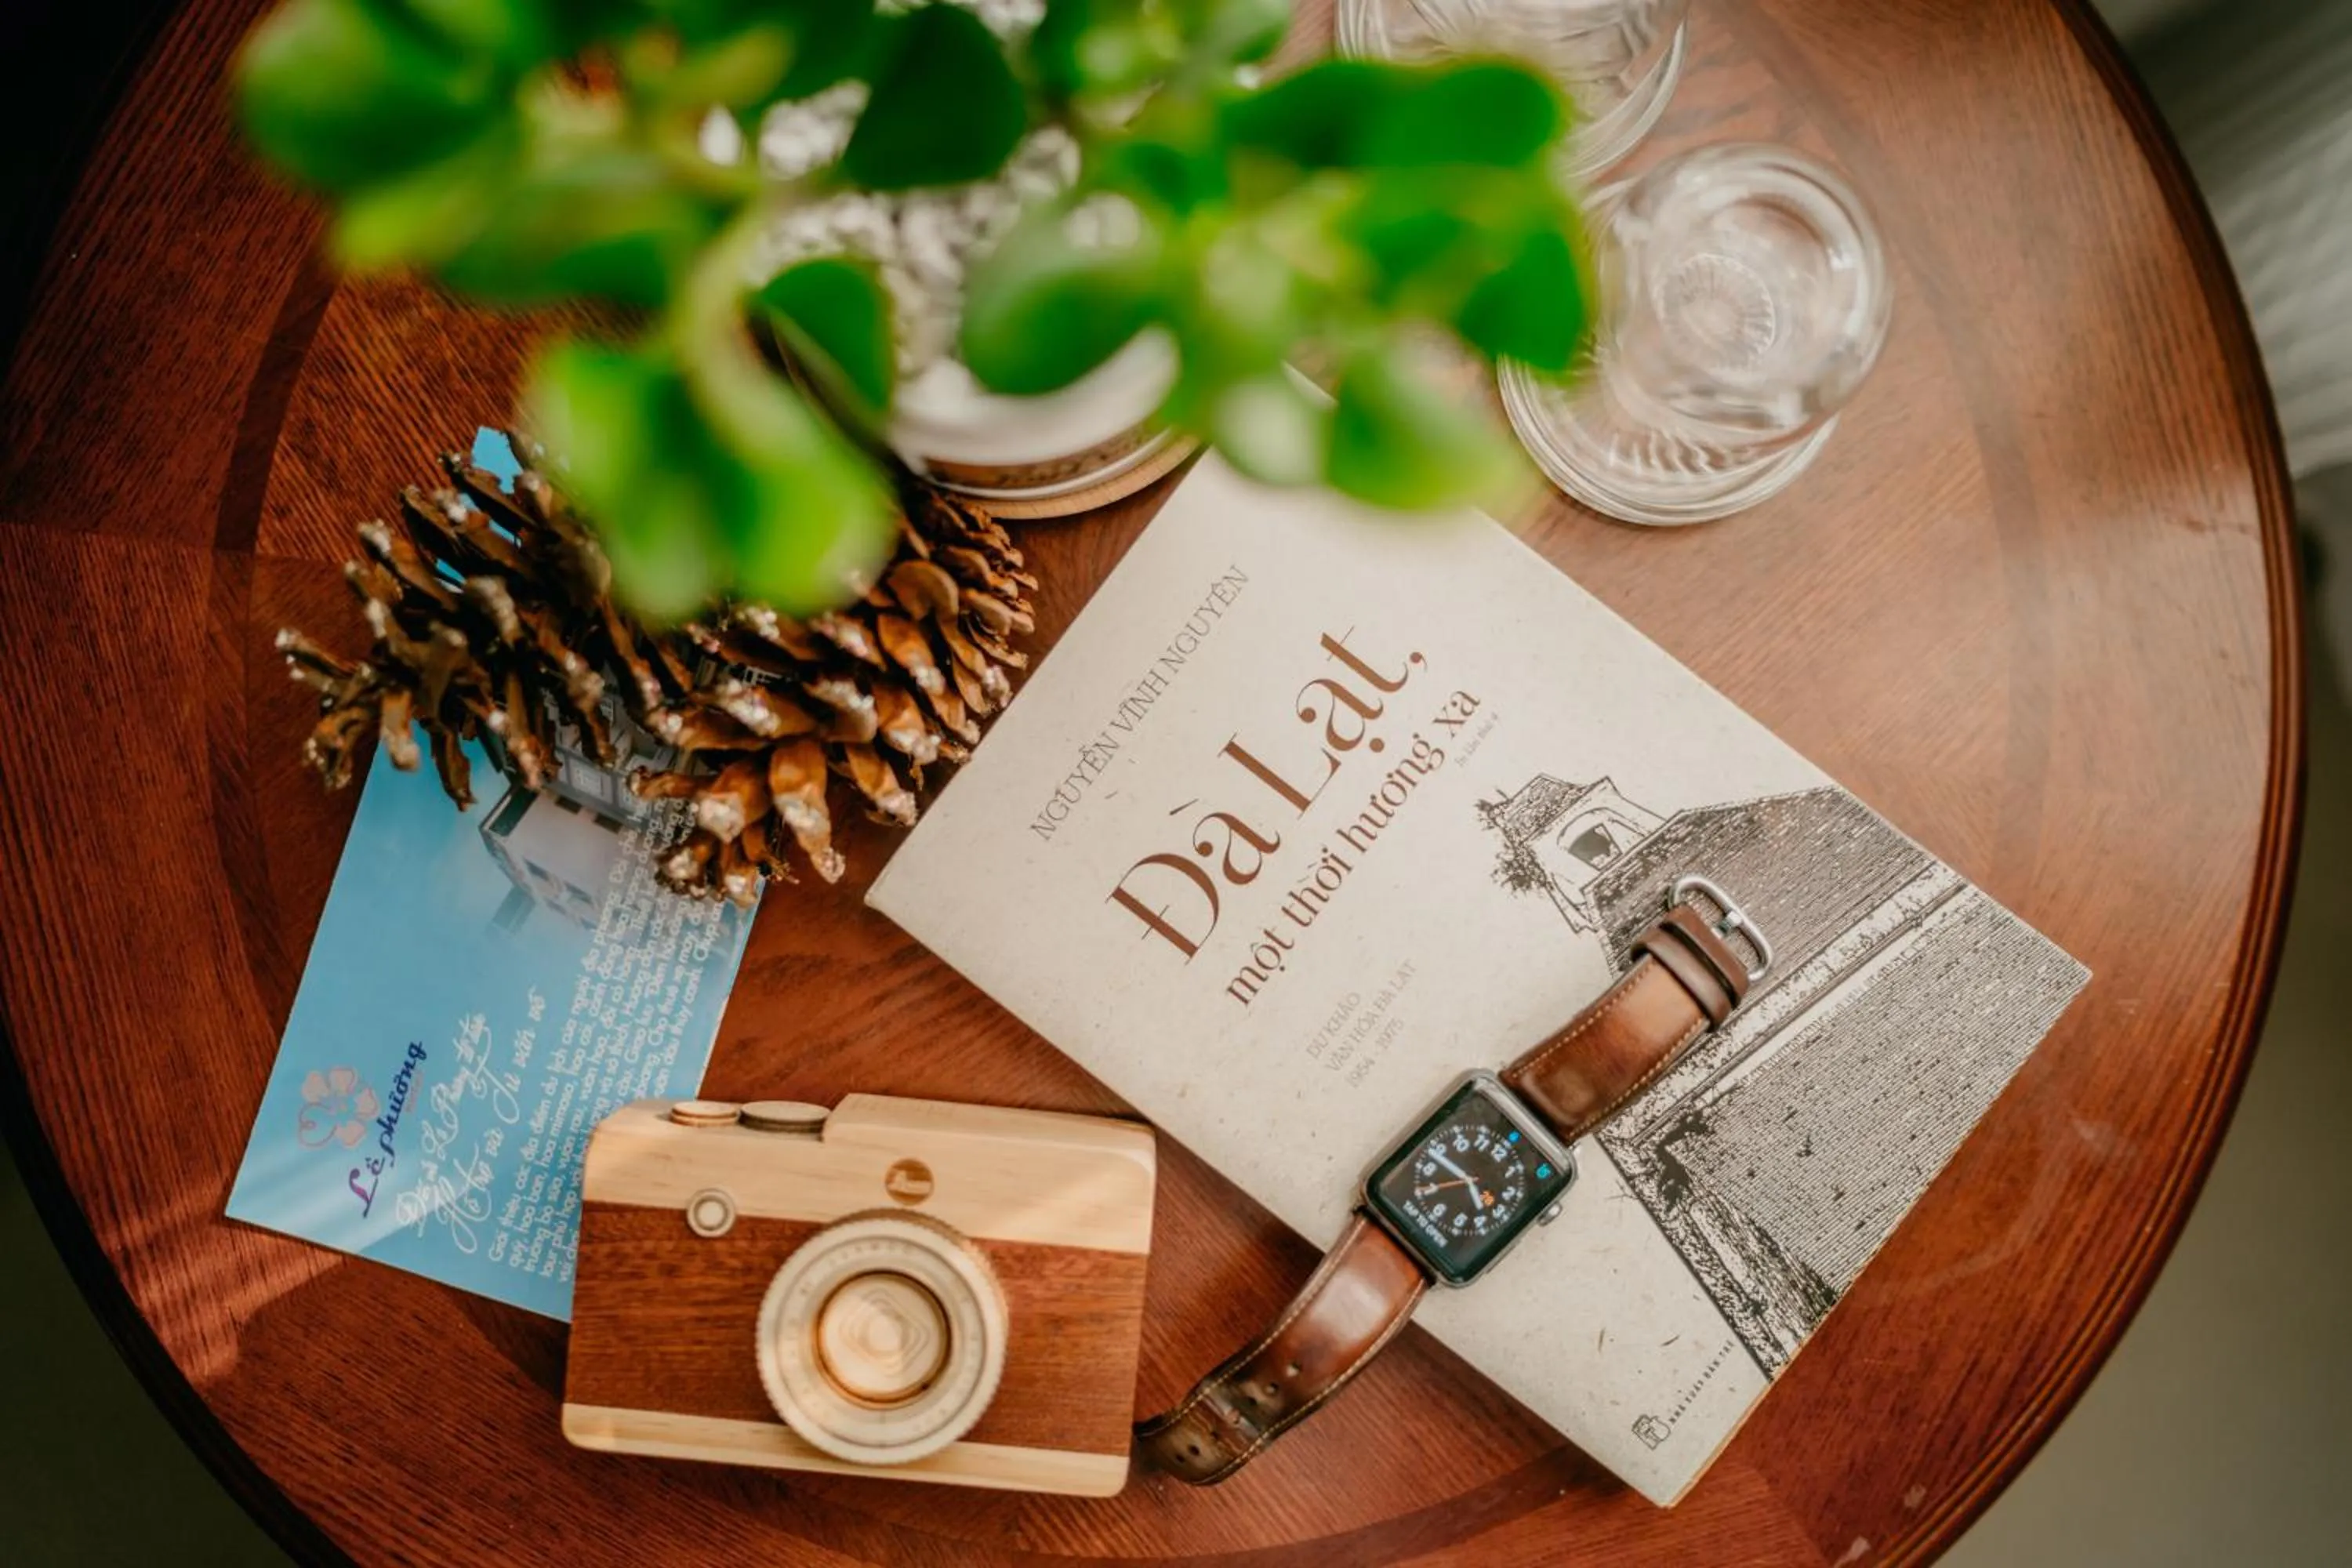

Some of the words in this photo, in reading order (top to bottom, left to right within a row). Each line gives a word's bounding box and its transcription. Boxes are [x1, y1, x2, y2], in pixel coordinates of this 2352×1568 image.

[1105, 800, 1281, 964] Đà
[1217, 626, 1428, 818] Lạt,
[1227, 929, 1294, 1005] một
[1282, 848, 1352, 927] thời
[1336, 734, 1444, 853] hương
[1433, 691, 1480, 738] xa
[1452, 1133, 1471, 1153] 10
[1472, 1134, 1490, 1151] 11
[1490, 1143, 1508, 1162] 12
[1421, 1161, 1437, 1176] 8
[1501, 1185, 1516, 1201] 2
[1432, 1203, 1447, 1218] 6
[1491, 1203, 1506, 1218] 3
